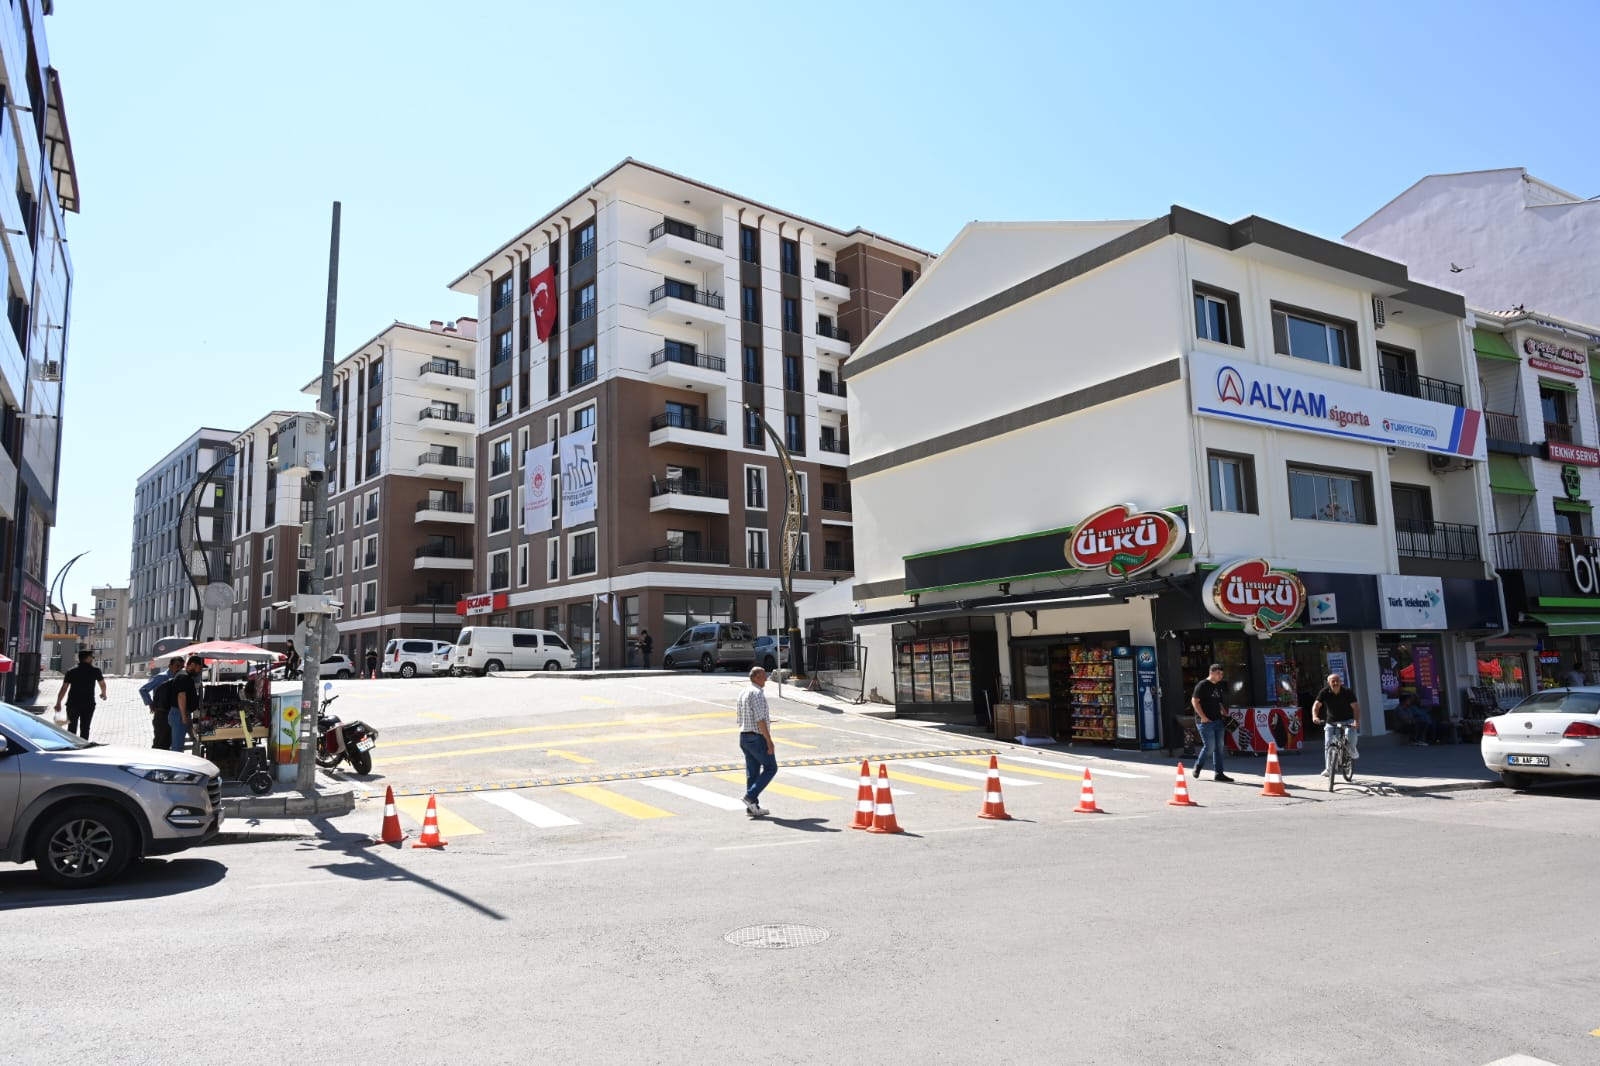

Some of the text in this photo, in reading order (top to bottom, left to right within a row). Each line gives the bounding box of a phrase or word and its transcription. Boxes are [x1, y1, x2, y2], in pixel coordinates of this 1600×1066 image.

[1250, 381, 1371, 427] ALYAM sigorta
[1077, 518, 1158, 555] ÜLKÜ
[467, 596, 492, 609] ECZANE
[1226, 575, 1294, 606] ÜLKÜ
[1388, 597, 1431, 608] Türk Telekom
